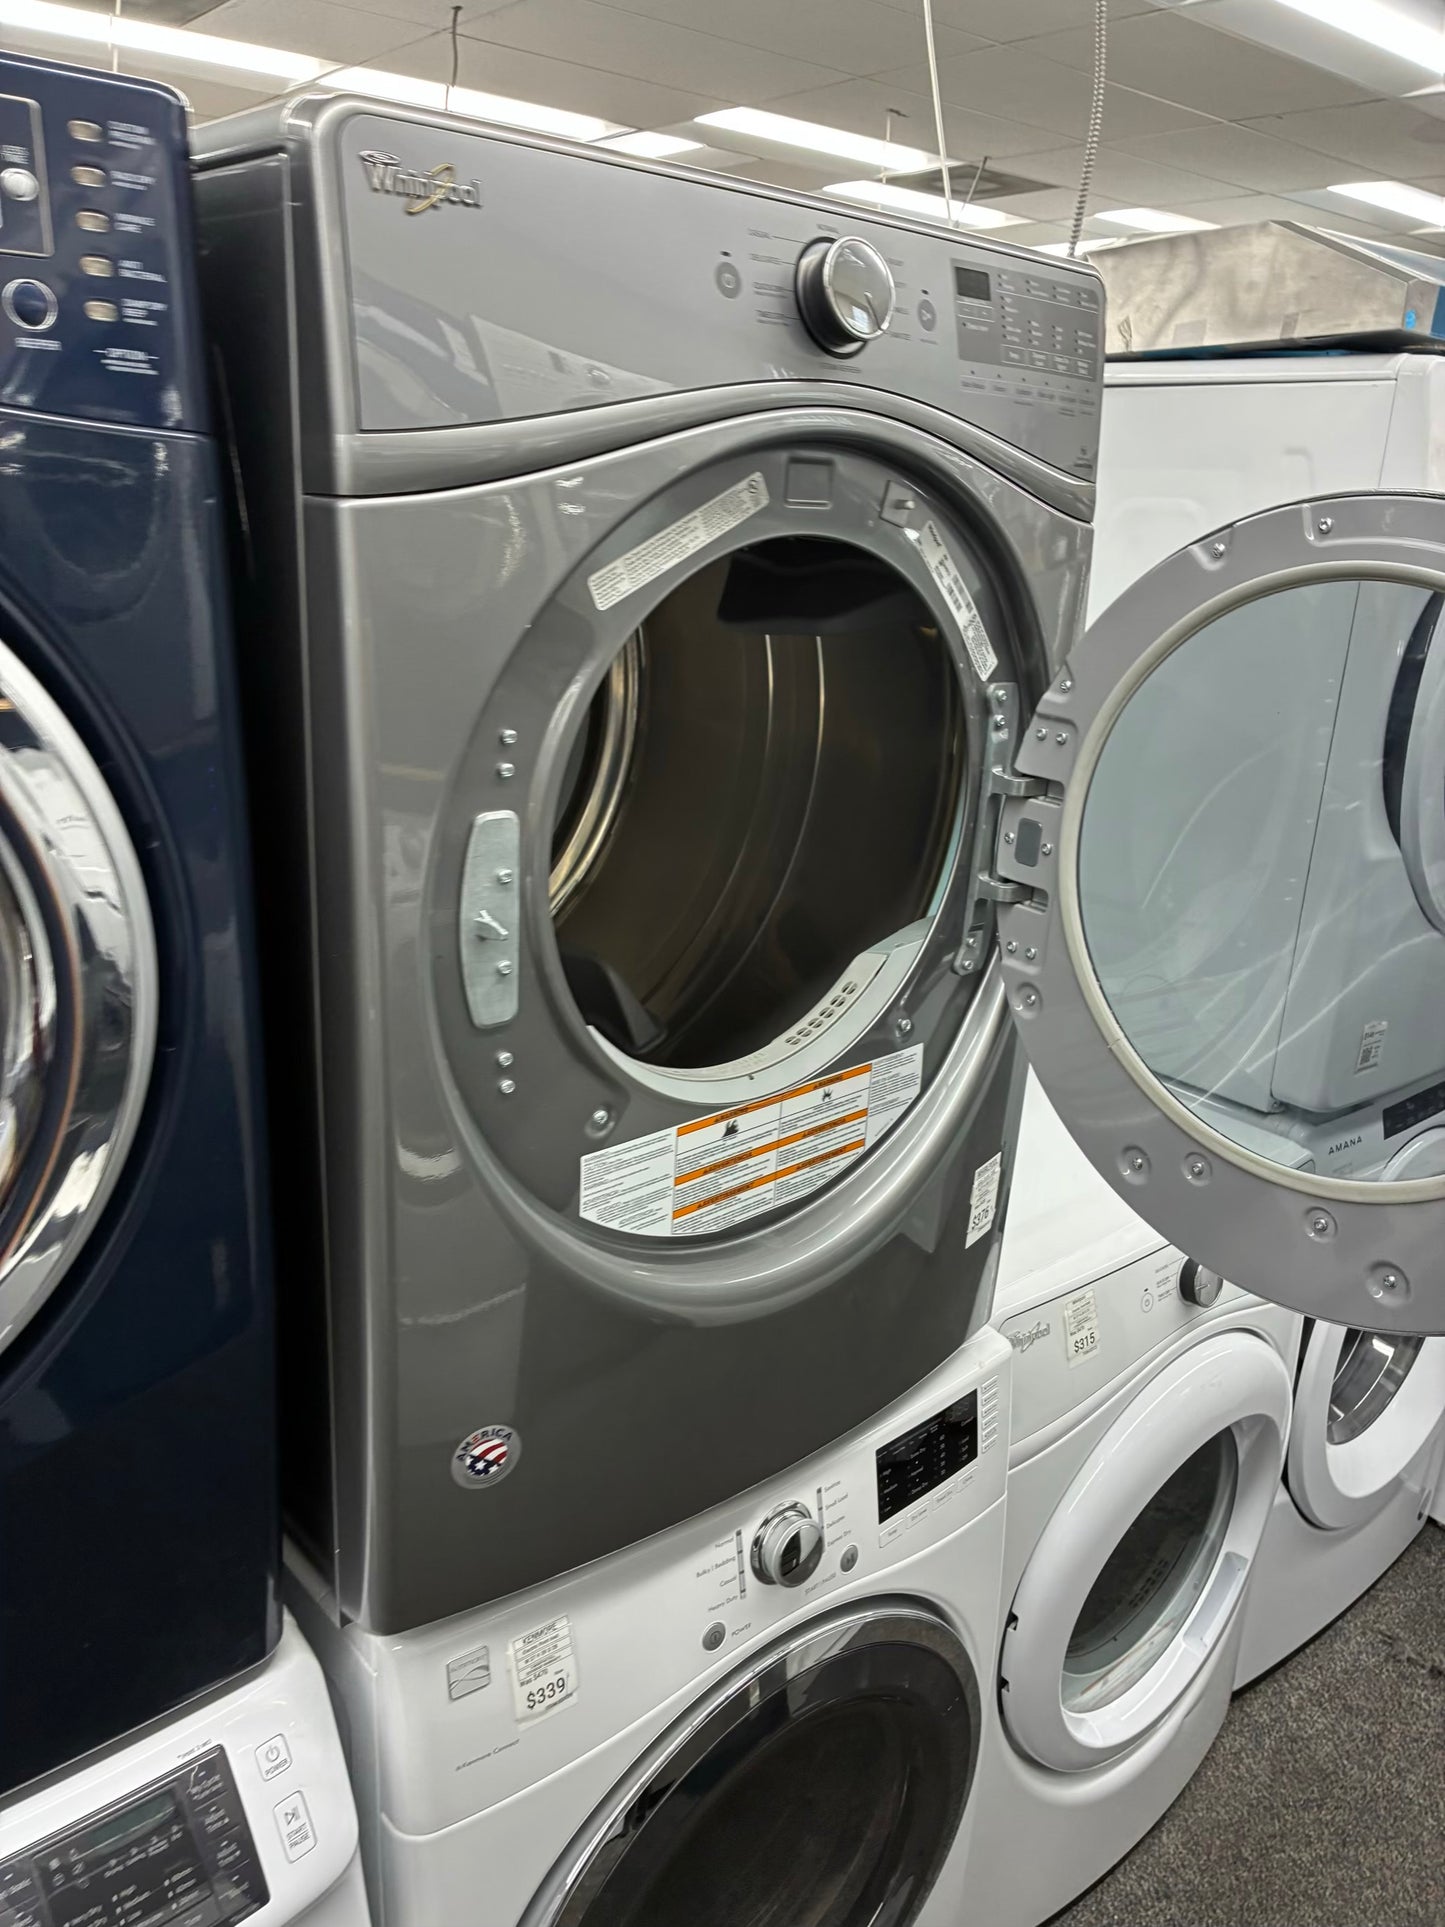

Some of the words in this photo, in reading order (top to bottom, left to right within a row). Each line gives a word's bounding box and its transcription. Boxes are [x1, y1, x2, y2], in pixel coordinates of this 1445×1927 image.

[1328, 1135, 1363, 1155] AMANA
[1074, 1332, 1096, 1353] $315
[456, 1428, 513, 1462] AMERICA
[526, 1677, 565, 1710] $339
[265, 1758, 288, 1776] POWER
